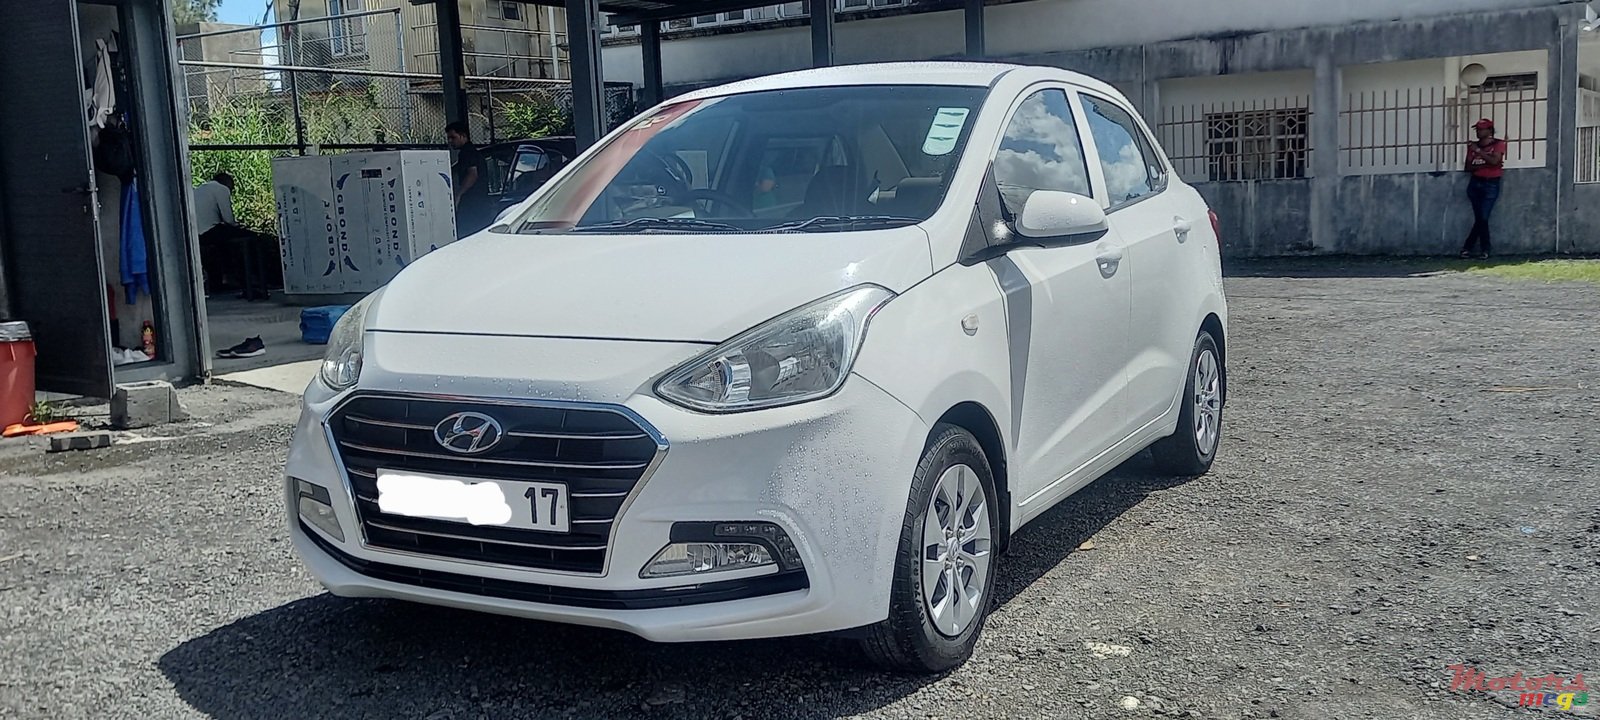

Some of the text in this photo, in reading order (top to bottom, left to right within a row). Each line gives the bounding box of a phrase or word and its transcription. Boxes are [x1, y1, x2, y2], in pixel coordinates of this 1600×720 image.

[337, 194, 348, 252] GBOND
[389, 192, 399, 250] GBOND
[524, 487, 558, 525] 17
